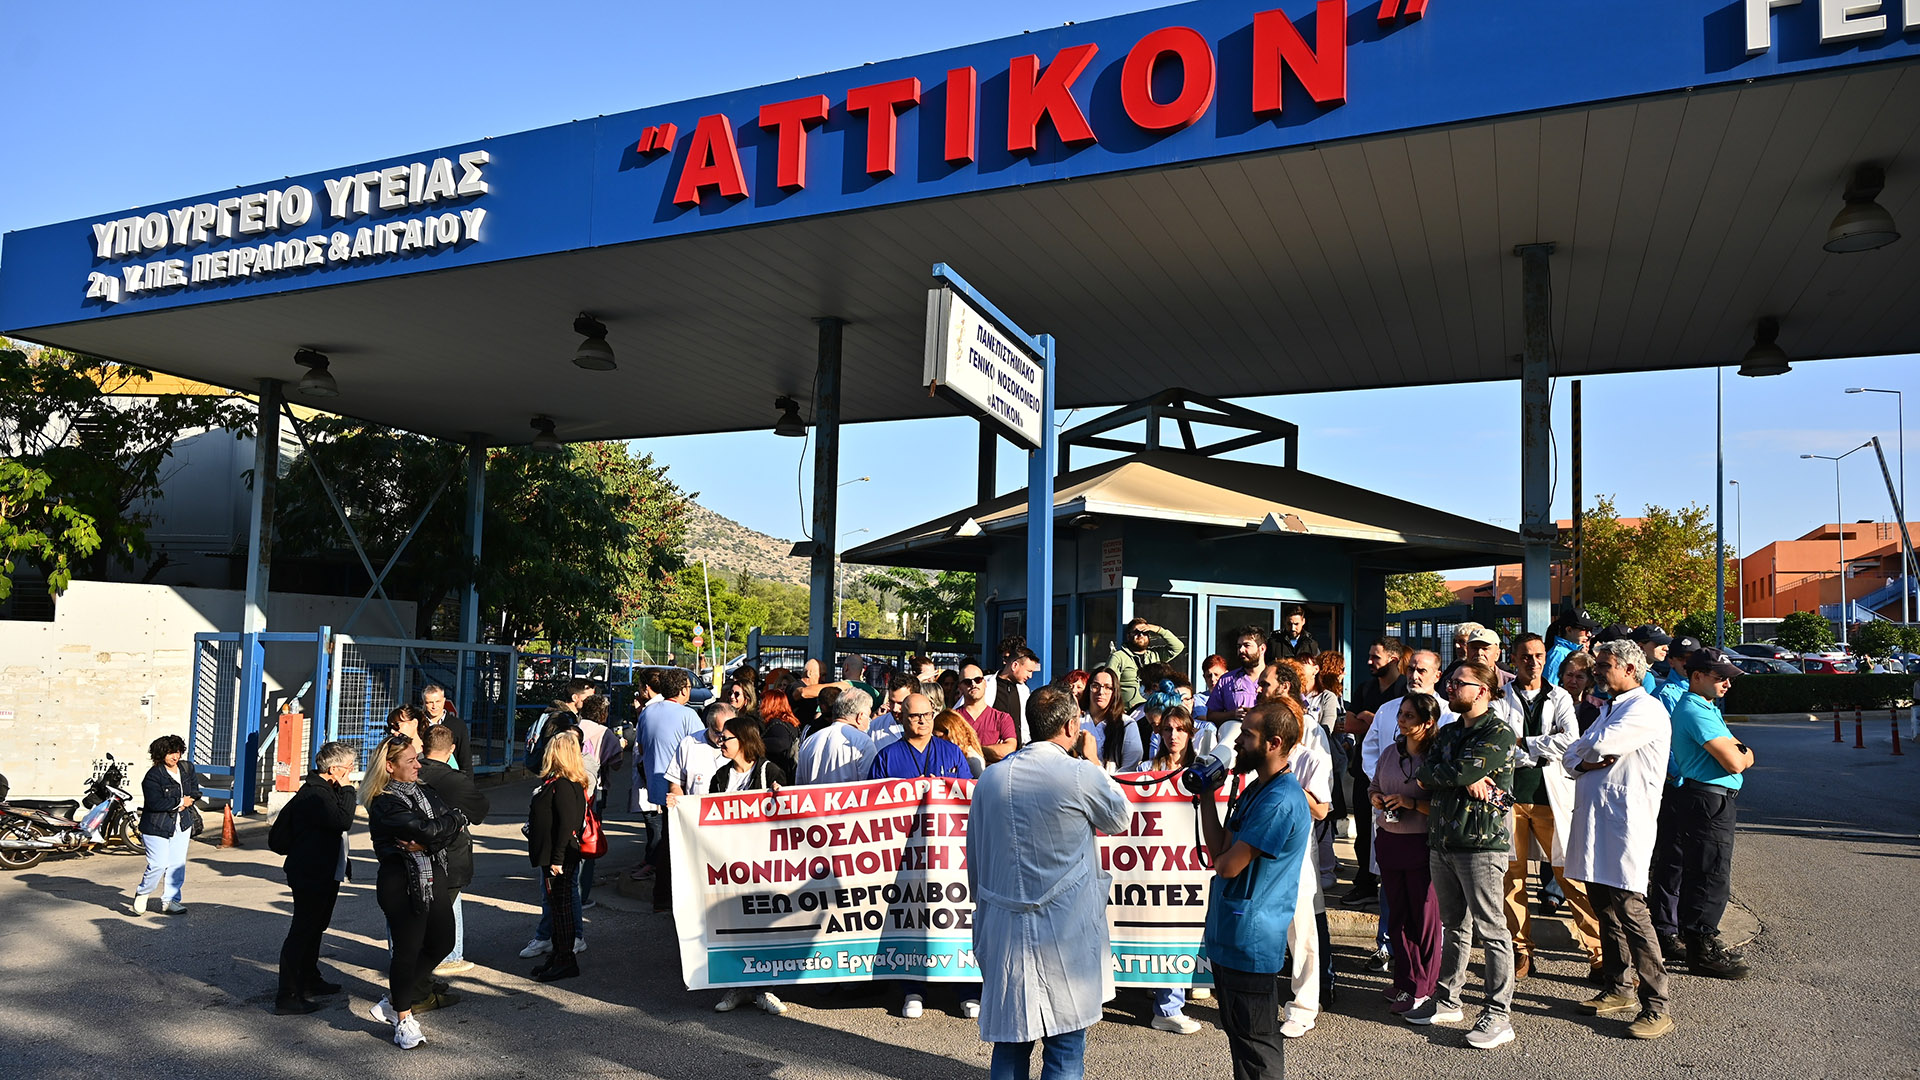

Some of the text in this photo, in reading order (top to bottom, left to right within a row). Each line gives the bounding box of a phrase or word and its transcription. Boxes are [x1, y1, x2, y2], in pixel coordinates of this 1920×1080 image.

[1744, 0, 1920, 55] ΓΕ
[92, 150, 490, 259] ΥΠΟΥΡΓΕΙΟ ΥΓΕΙΑΣ
[86, 271, 119, 303] 2η
[976, 324, 1034, 384] ΠΑΝΕΠΙΣΤΗΜΙΑΚΟ
[969, 347, 1040, 413] ΓΕΝΙΚΟ ΝΟΣΟΚΟΜΕΙΟ
[849, 623, 857, 635] P
[704, 792, 817, 821] ΔΗΜΟΣΙΑ
[824, 788, 869, 812] ΚΑΙ
[769, 812, 969, 852] ΠΡΟΣΛΗΨΕΙΣ
[707, 846, 949, 885] ΜΟΝΙΜΟΠΟΙΗΣΗ
[741, 894, 793, 915] ΕΞΩ
[798, 891, 829, 912] ΟΙ
[1107, 884, 1204, 906] ΙΩΤΕΣ
[826, 910, 883, 934] ΑΠΟ
[742, 951, 833, 977] Σωματείο
[837, 946, 953, 974] Εργαζομένων
